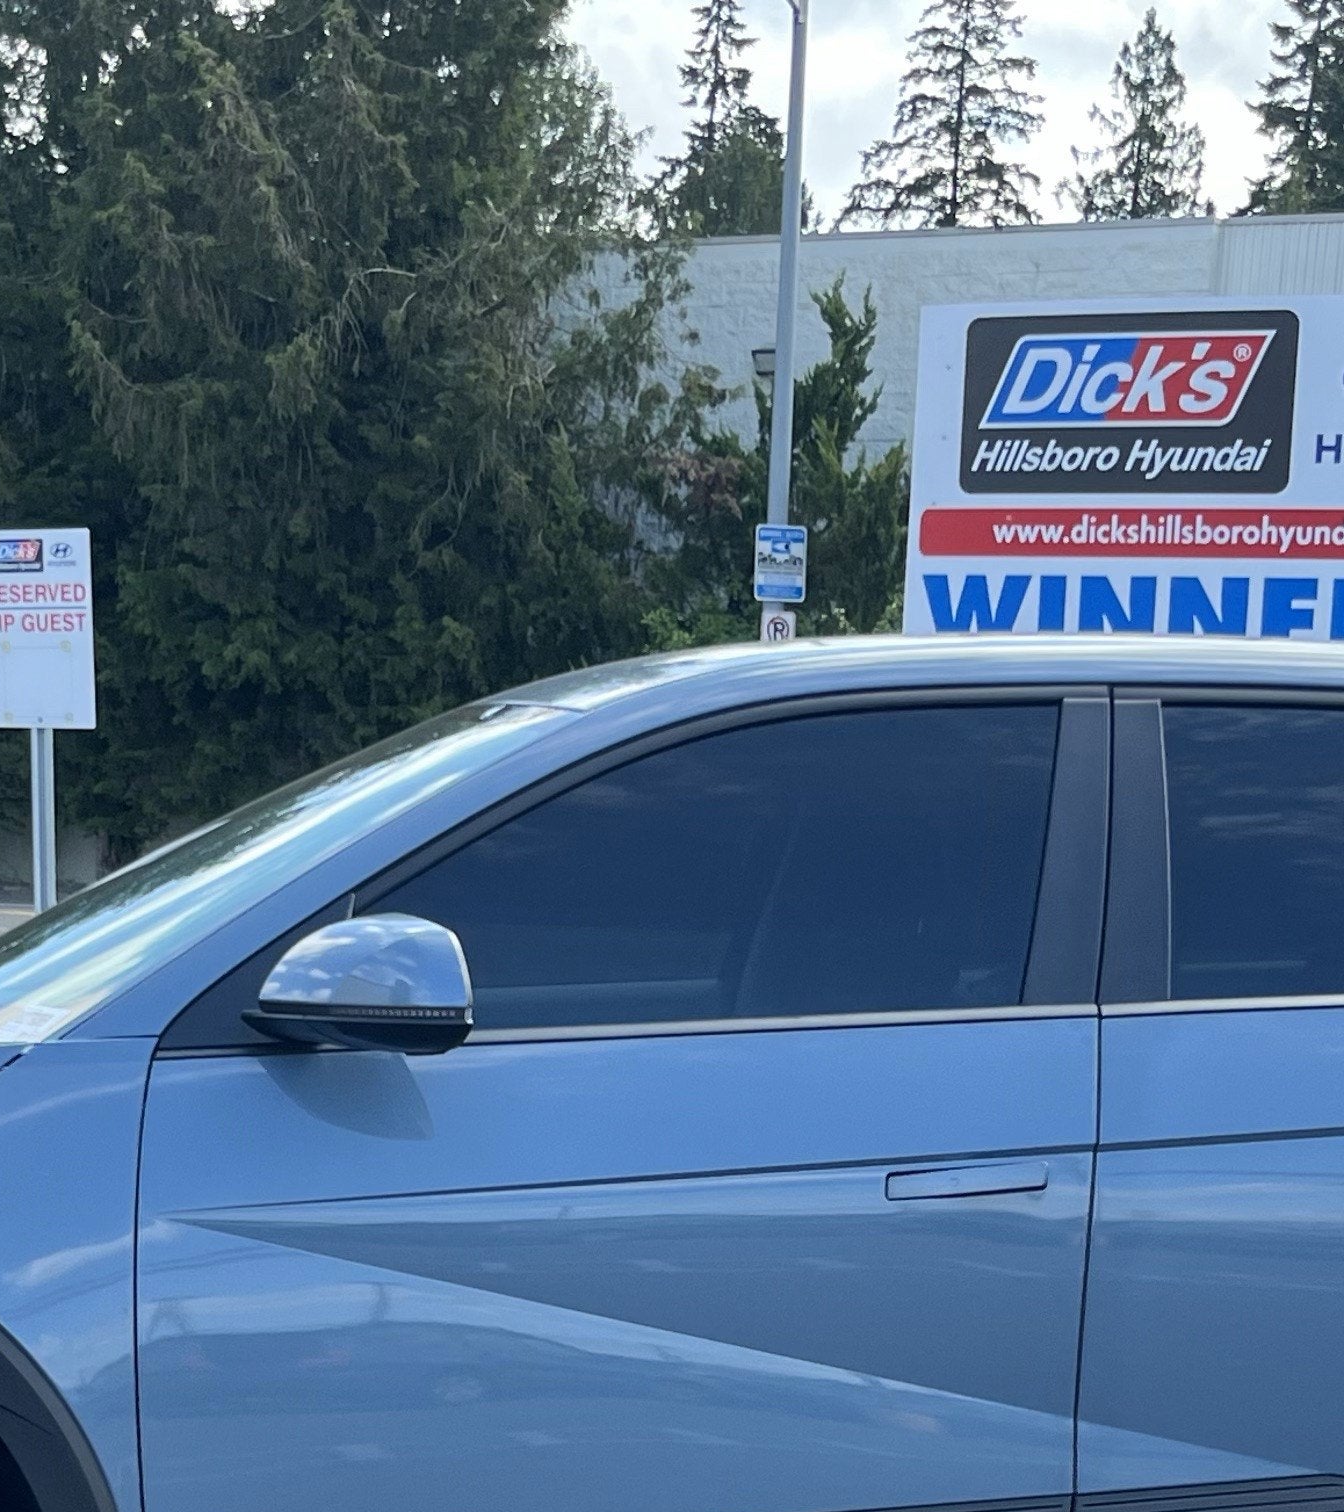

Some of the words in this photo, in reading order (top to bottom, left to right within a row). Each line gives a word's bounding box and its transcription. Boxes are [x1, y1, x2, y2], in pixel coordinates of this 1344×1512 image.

[1001, 341, 1237, 415] Dick's
[970, 439, 1121, 473] Hillsboro
[1123, 438, 1273, 481] Hyundai
[21, 612, 87, 633] GUEST
